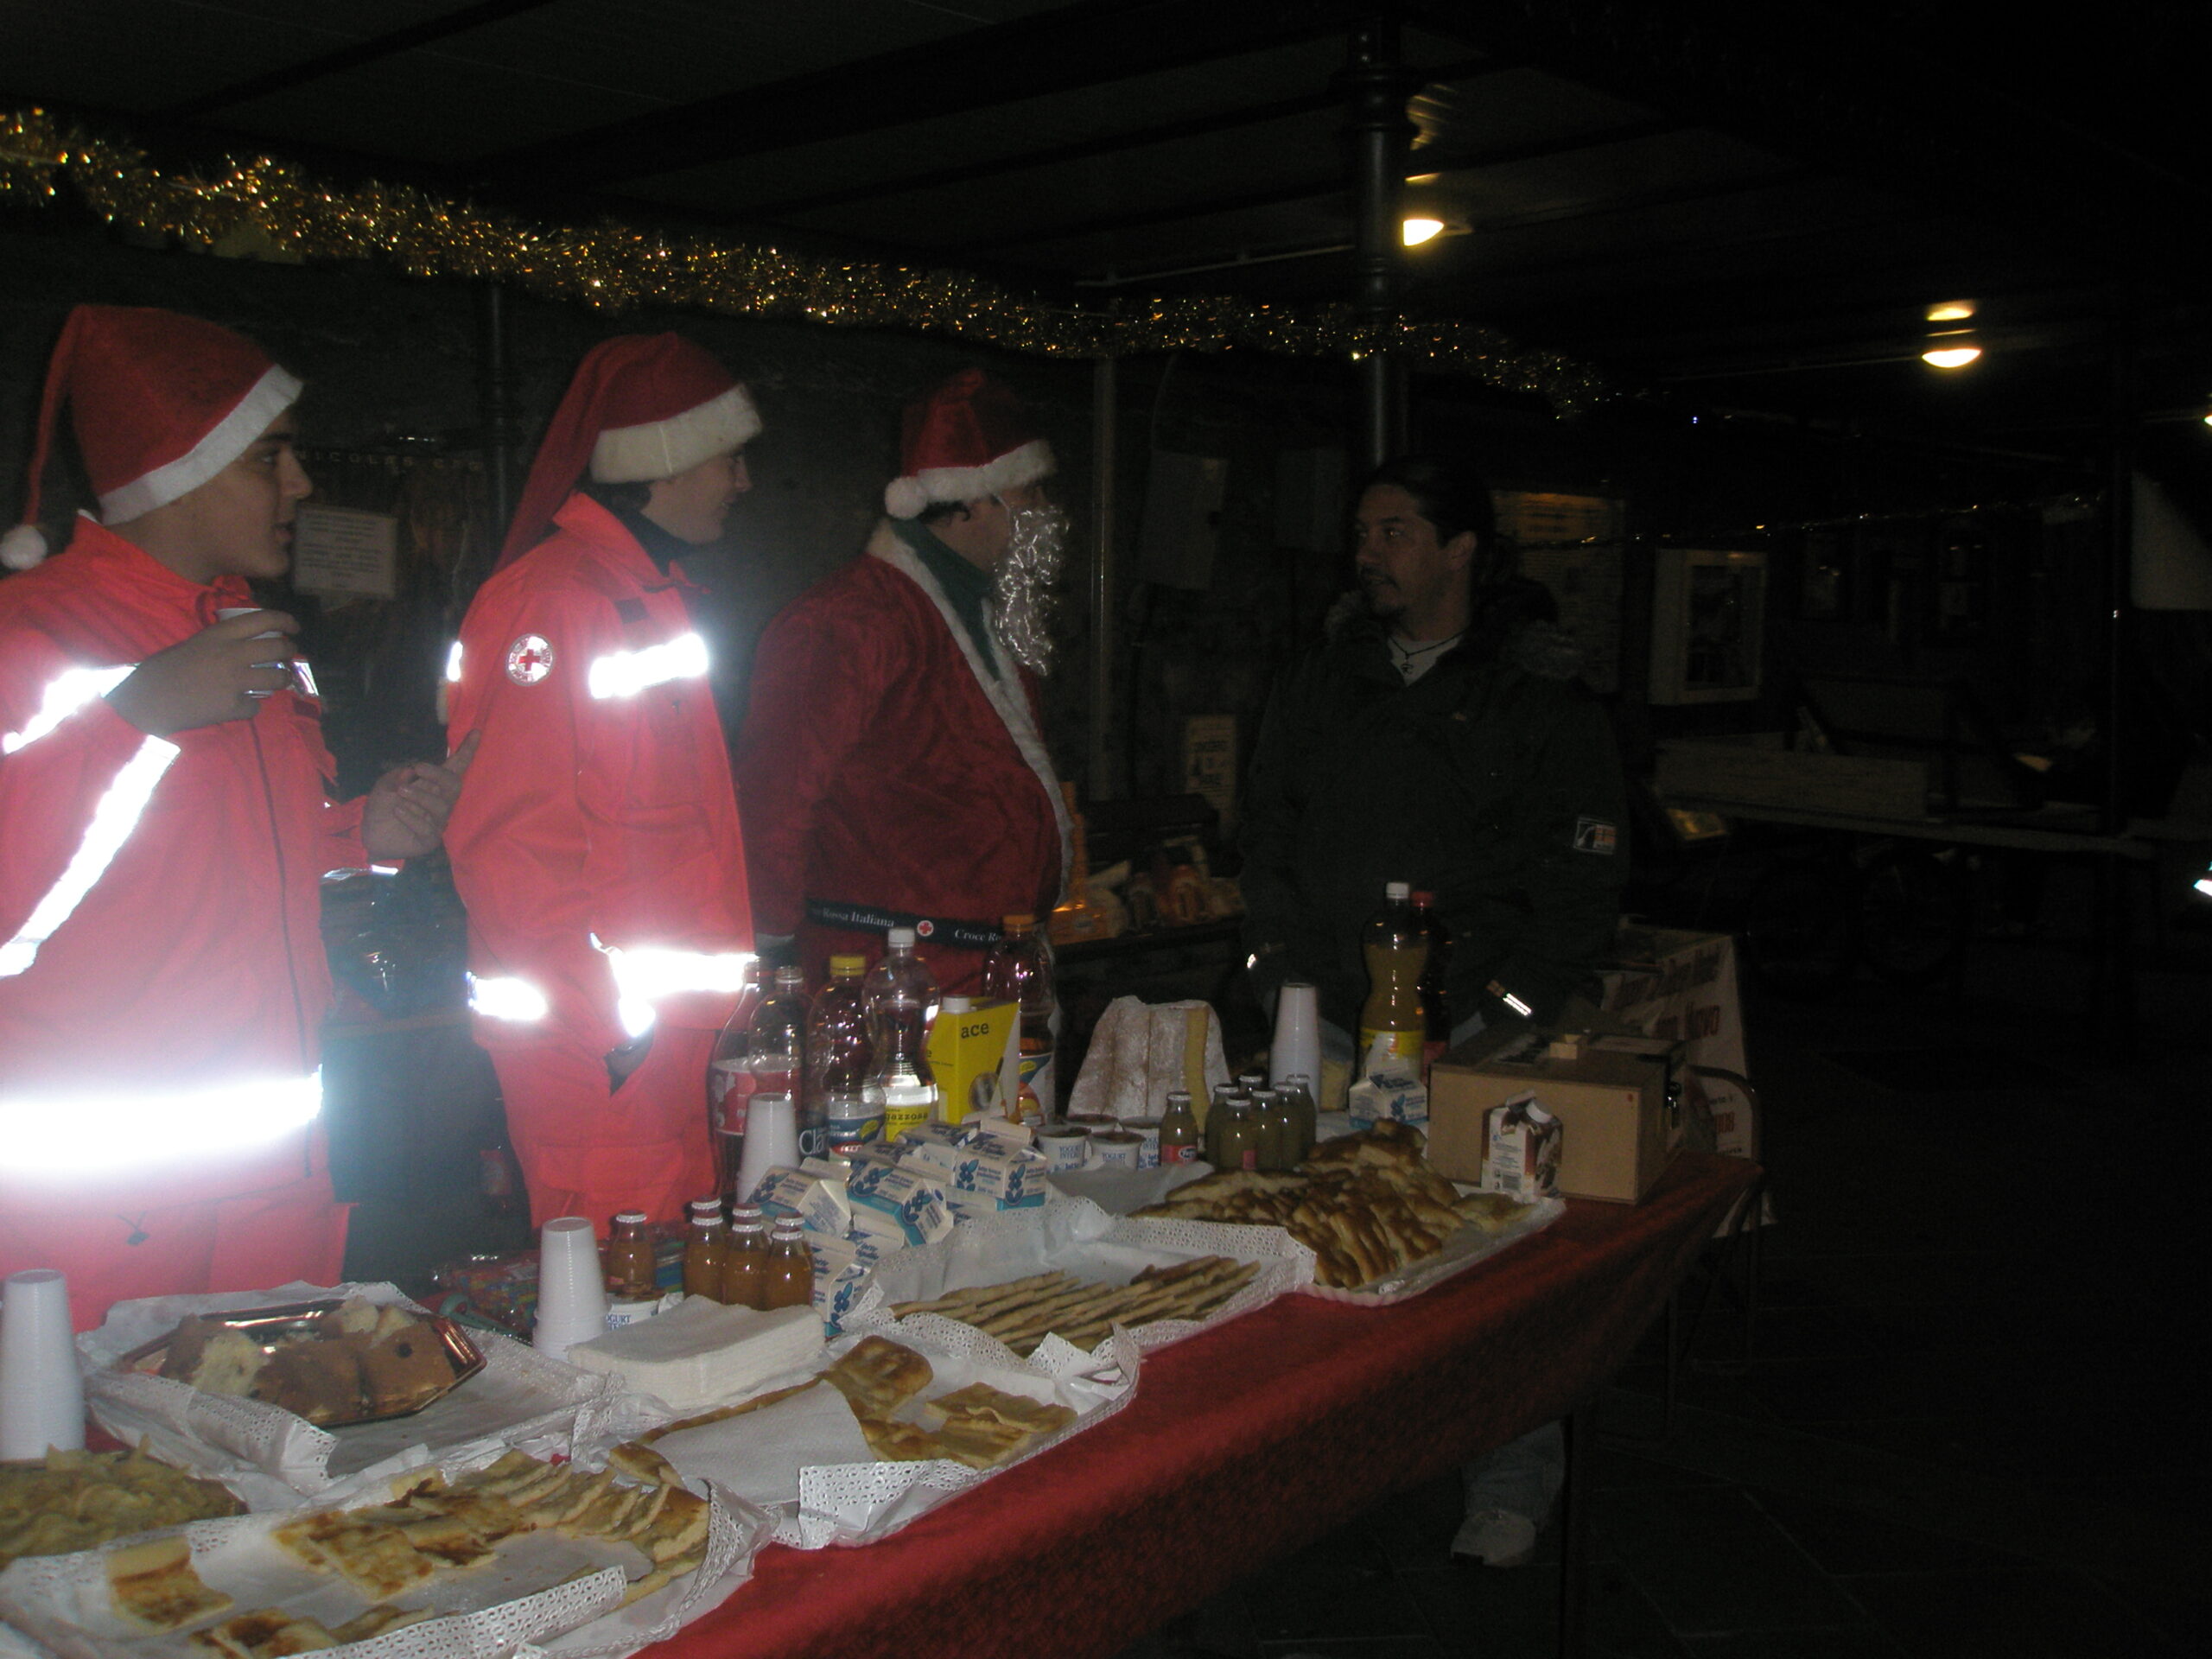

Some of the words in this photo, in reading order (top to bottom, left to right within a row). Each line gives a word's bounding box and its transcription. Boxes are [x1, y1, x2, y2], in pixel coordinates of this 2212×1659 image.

[851, 911, 895, 928] Italiana
[954, 928, 986, 941] Croce
[961, 1022, 990, 1039] ace
[1102, 1153, 1127, 1161] YOGURT
